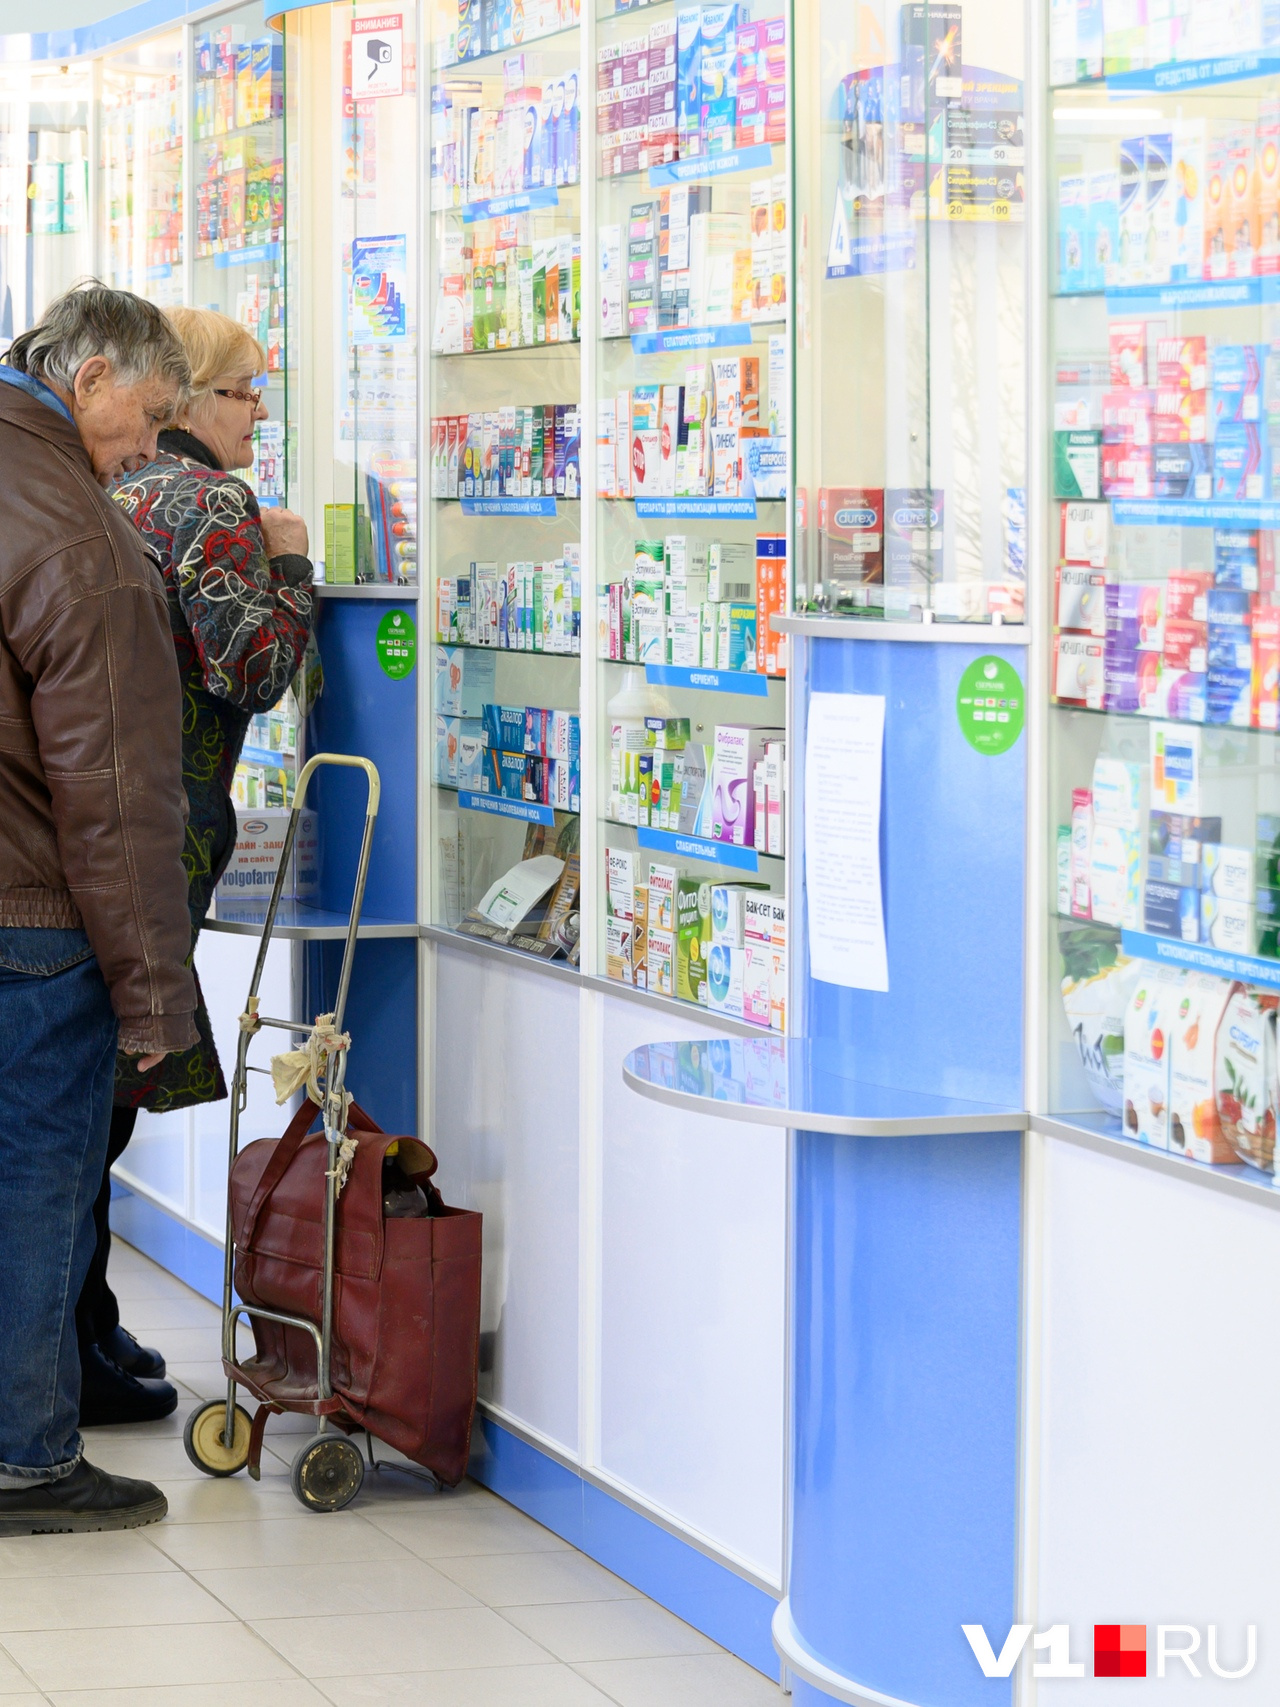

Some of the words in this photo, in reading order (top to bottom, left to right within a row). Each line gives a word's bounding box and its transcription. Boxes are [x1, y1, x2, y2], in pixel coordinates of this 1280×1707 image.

[354, 16, 400, 32] ВНИМАНИЕ!
[680, 14, 698, 25] Маалокс
[703, 14, 725, 25] Маалокс
[704, 60, 726, 71] Маалокс
[1154, 66, 1198, 86] СРЕДСТВА
[1199, 66, 1210, 78] ОТ
[950, 150, 962, 159] 20
[994, 150, 1006, 159] 50
[678, 162, 708, 176] ПРЕПАРАТЫ
[708, 160, 716, 172] ОТ
[632, 206, 649, 216] ТРИМЕДАТ
[950, 206, 962, 214] 20
[991, 206, 1008, 214] 100
[630, 242, 651, 254] ТРИМЕДАТ
[630, 288, 651, 300] ТРИМЕДАТ
[663, 332, 716, 348] ГЕПАТОПРОТЕКТОРЫ
[716, 362, 738, 380] ЛИНЕКС
[715, 433, 736, 448] ЛИНЕКС
[634, 448, 644, 470] STOP
[474, 503, 483, 512] ДЛЯ
[501, 502, 530, 512] ЗАБОЛЕВАНИЙ
[530, 502, 542, 512] НОСА
[637, 502, 665, 513] ПРЕПАРАТЫ
[666, 503, 676, 513] ДЛЯ
[676, 502, 716, 514] НОРМАЛИЗАЦИИ
[717, 502, 754, 514] МИКРОФЛОРЫ
[837, 512, 874, 524] durex
[896, 511, 934, 524] durex
[634, 604, 658, 616] Эспумизан
[690, 674, 718, 686] ФЕРМЕНТЫ
[718, 732, 744, 747] Фибралакс
[498, 802, 528, 816] ЗАБОЛЕВАНИЙ
[528, 808, 540, 820] НОСА
[676, 840, 717, 858] СЛАБИТЕЛЬНЫЕ
[250, 856, 274, 864] сайте
[610, 858, 628, 870] ФЕ-РОКС
[650, 876, 672, 892] ФИТОЛАКС
[678, 891, 697, 910] Фито
[746, 900, 770, 918] Бак-сет
[648, 938, 671, 955] ФИТОЛАКС
[1156, 942, 1236, 972] УСПОКОИТЕЛЬНЫЕ
